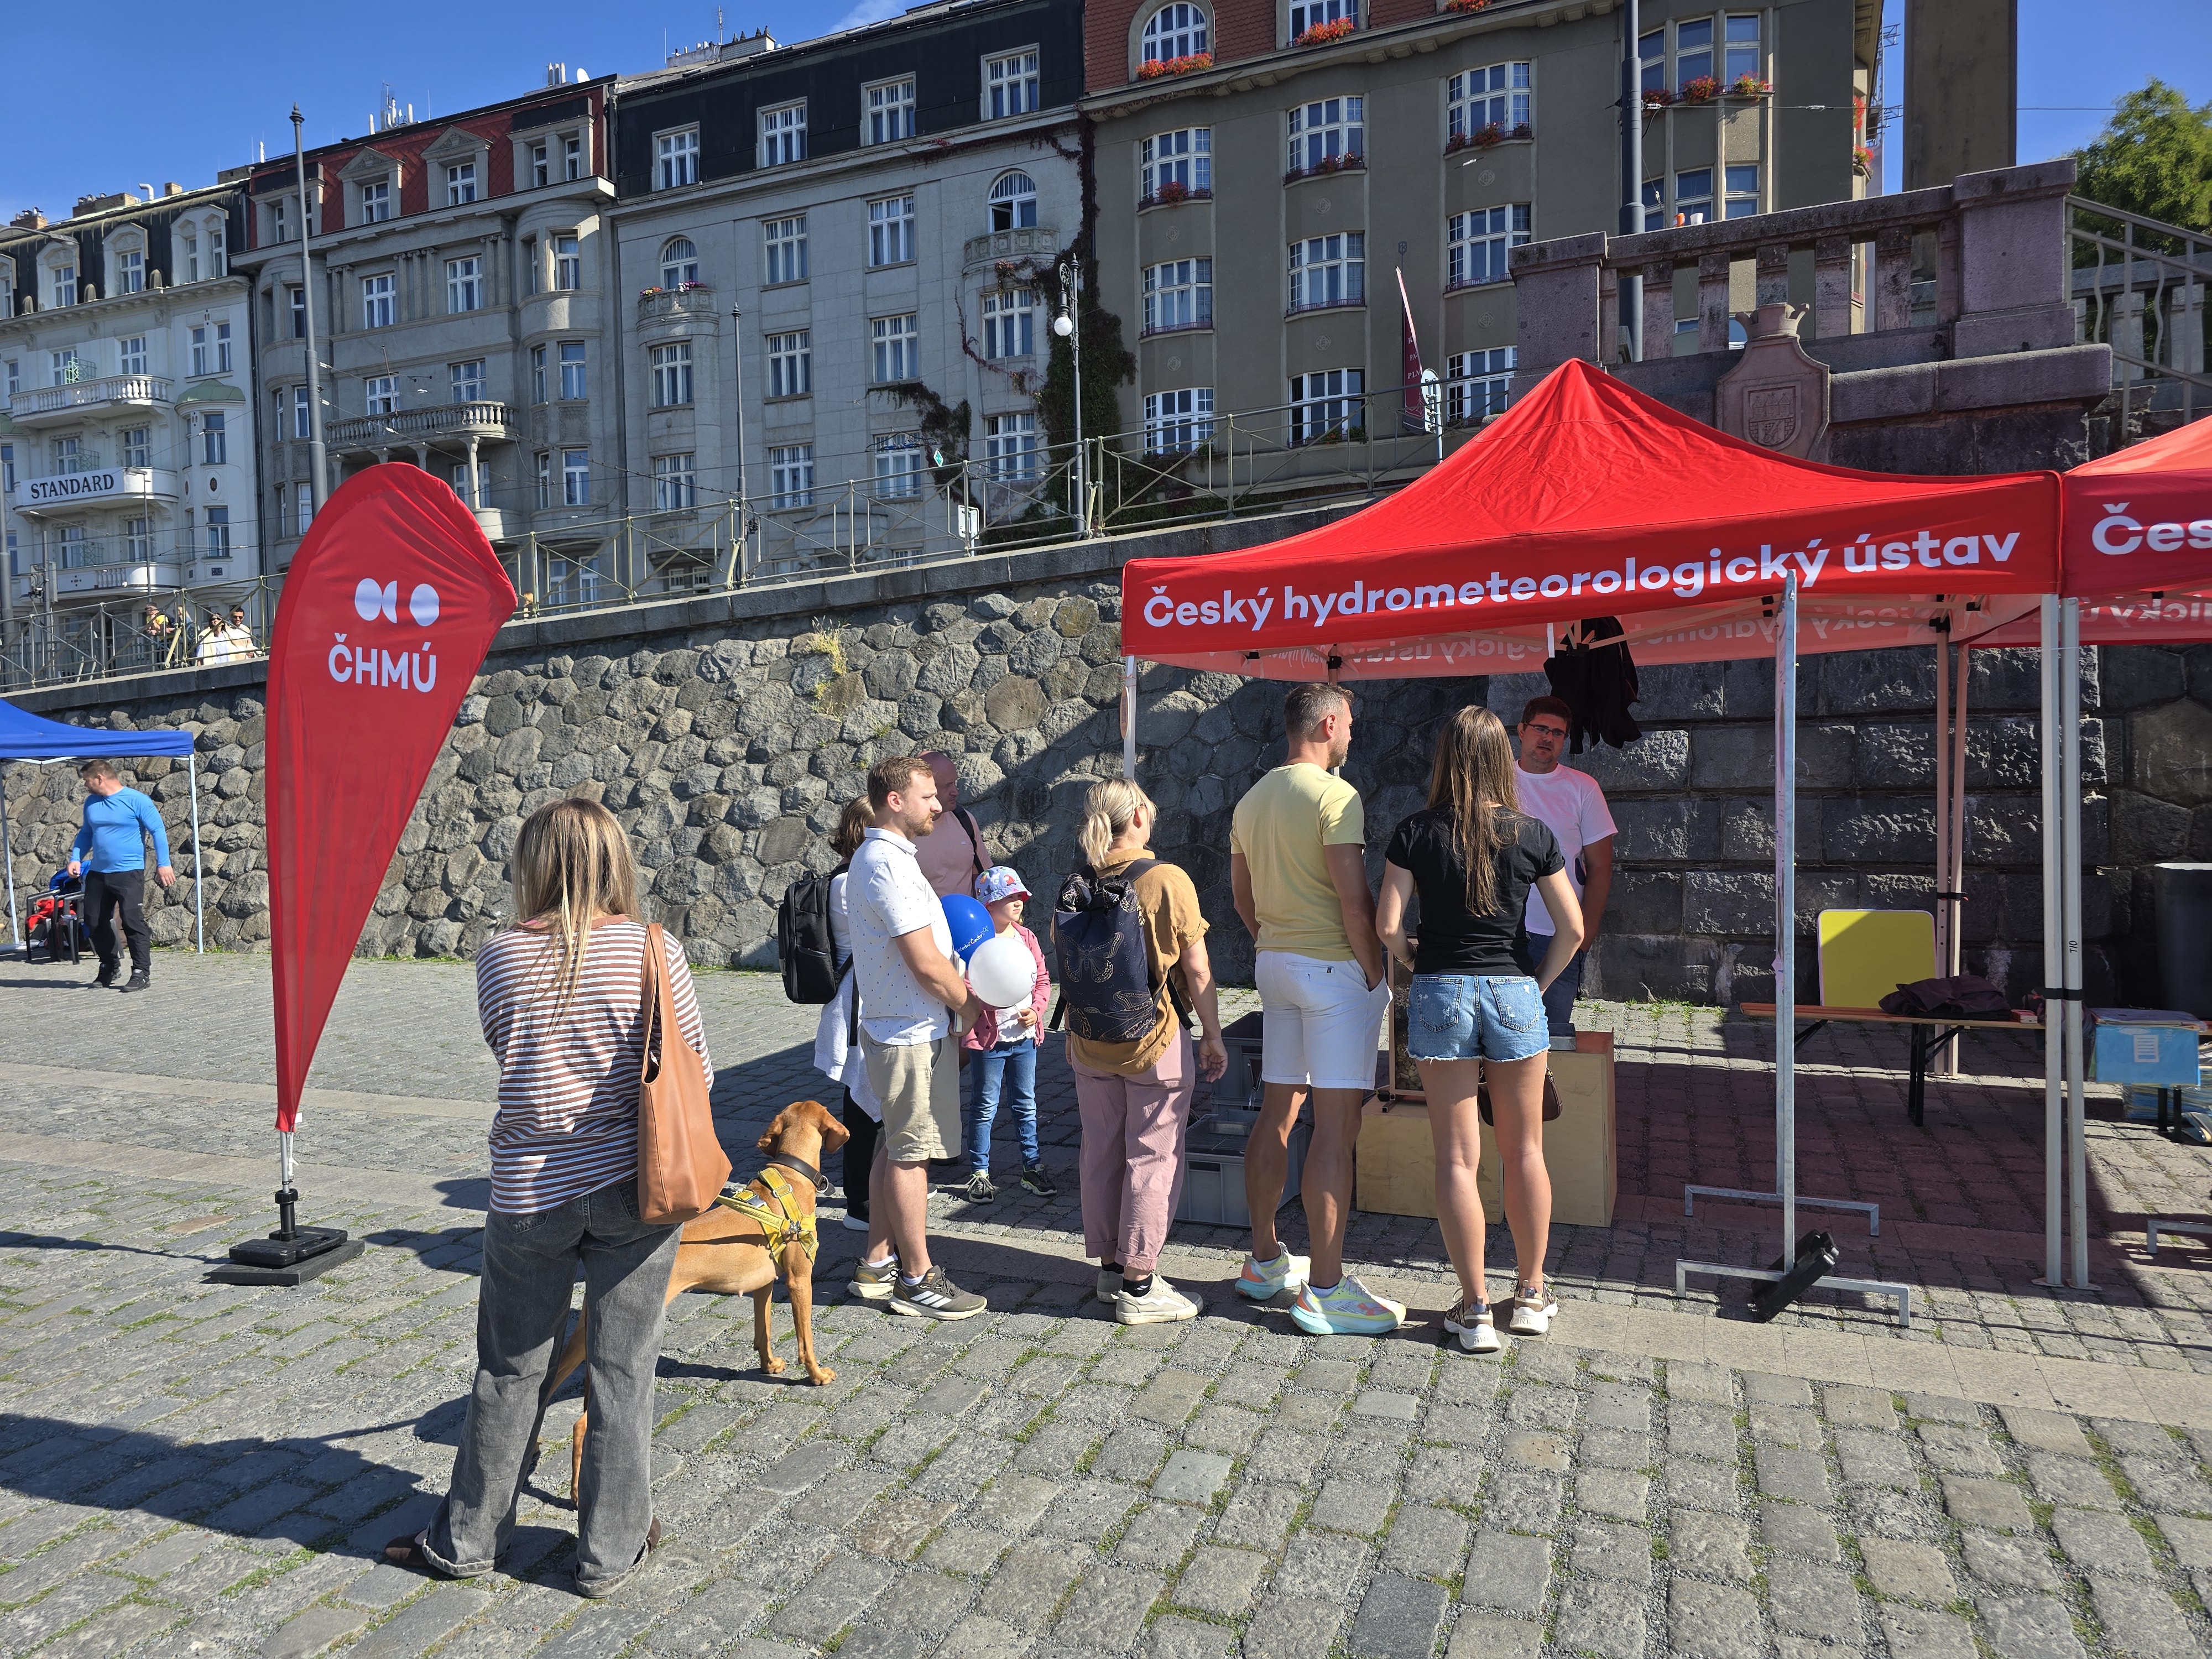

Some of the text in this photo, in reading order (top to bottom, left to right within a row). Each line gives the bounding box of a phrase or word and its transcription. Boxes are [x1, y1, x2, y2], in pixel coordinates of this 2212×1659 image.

[30, 474, 114, 499] STANDARD
[1144, 530, 2021, 631] Český hydrometeorologický ústav
[328, 632, 437, 693] ČHMÚ
